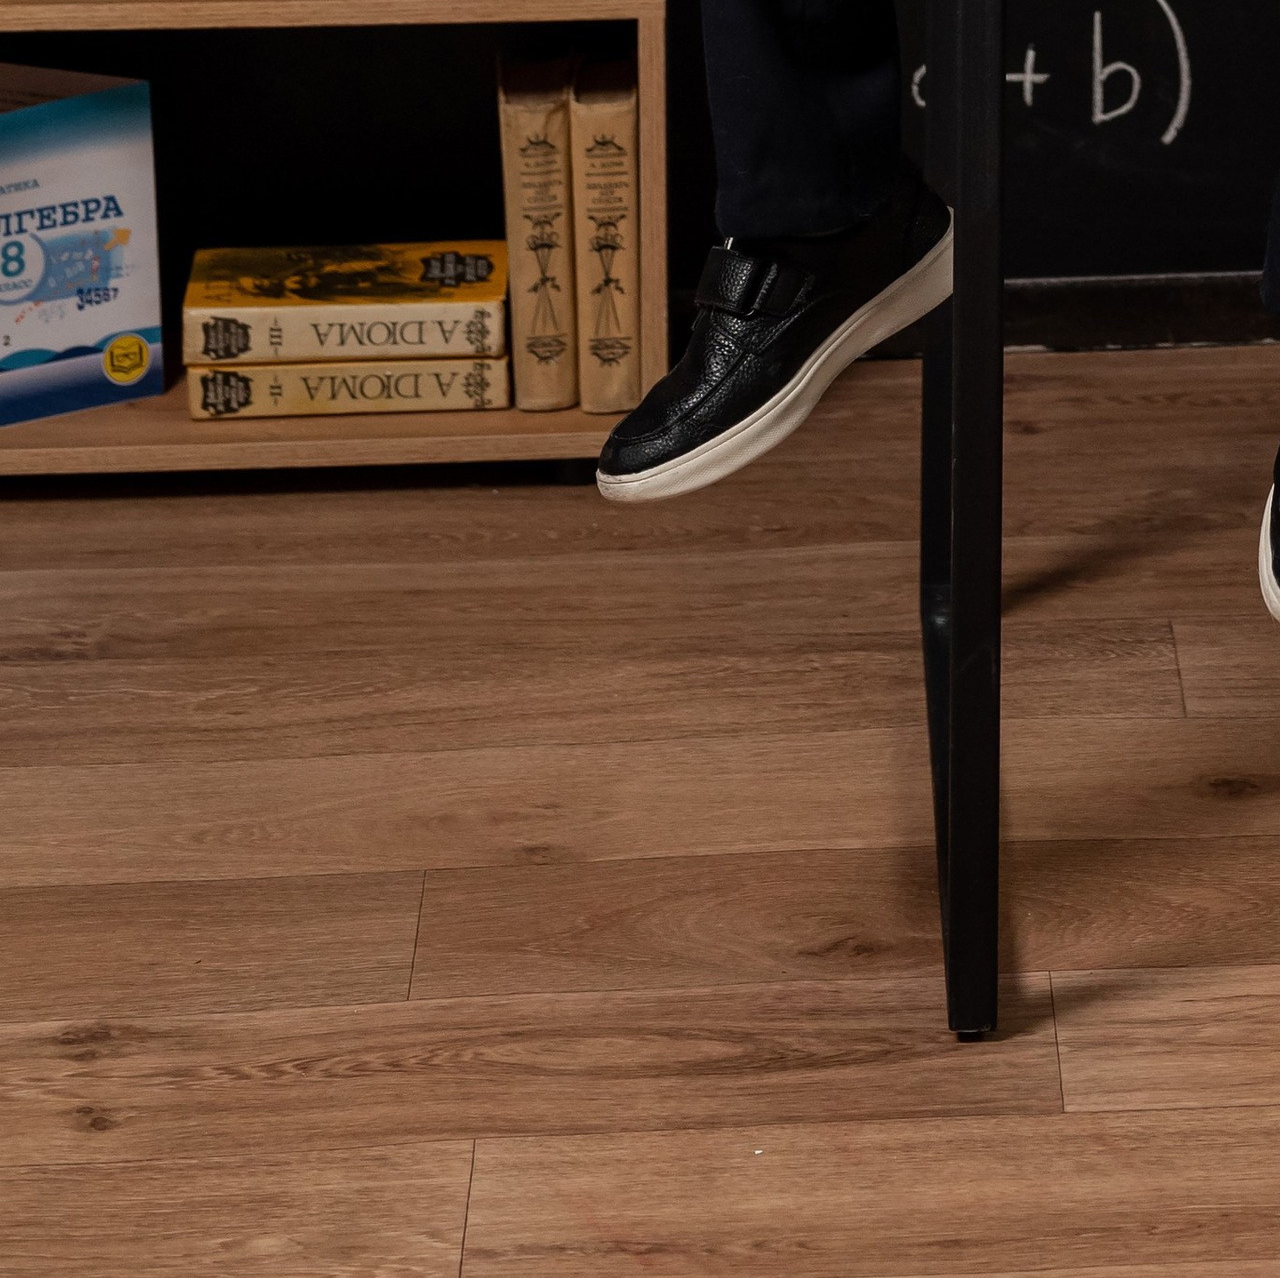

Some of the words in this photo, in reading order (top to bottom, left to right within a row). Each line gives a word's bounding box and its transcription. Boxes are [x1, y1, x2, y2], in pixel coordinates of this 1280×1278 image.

[1, 240, 26, 278] 8
[310, 320, 426, 347] ДЮМА
[299, 373, 422, 400] ДЮМА
